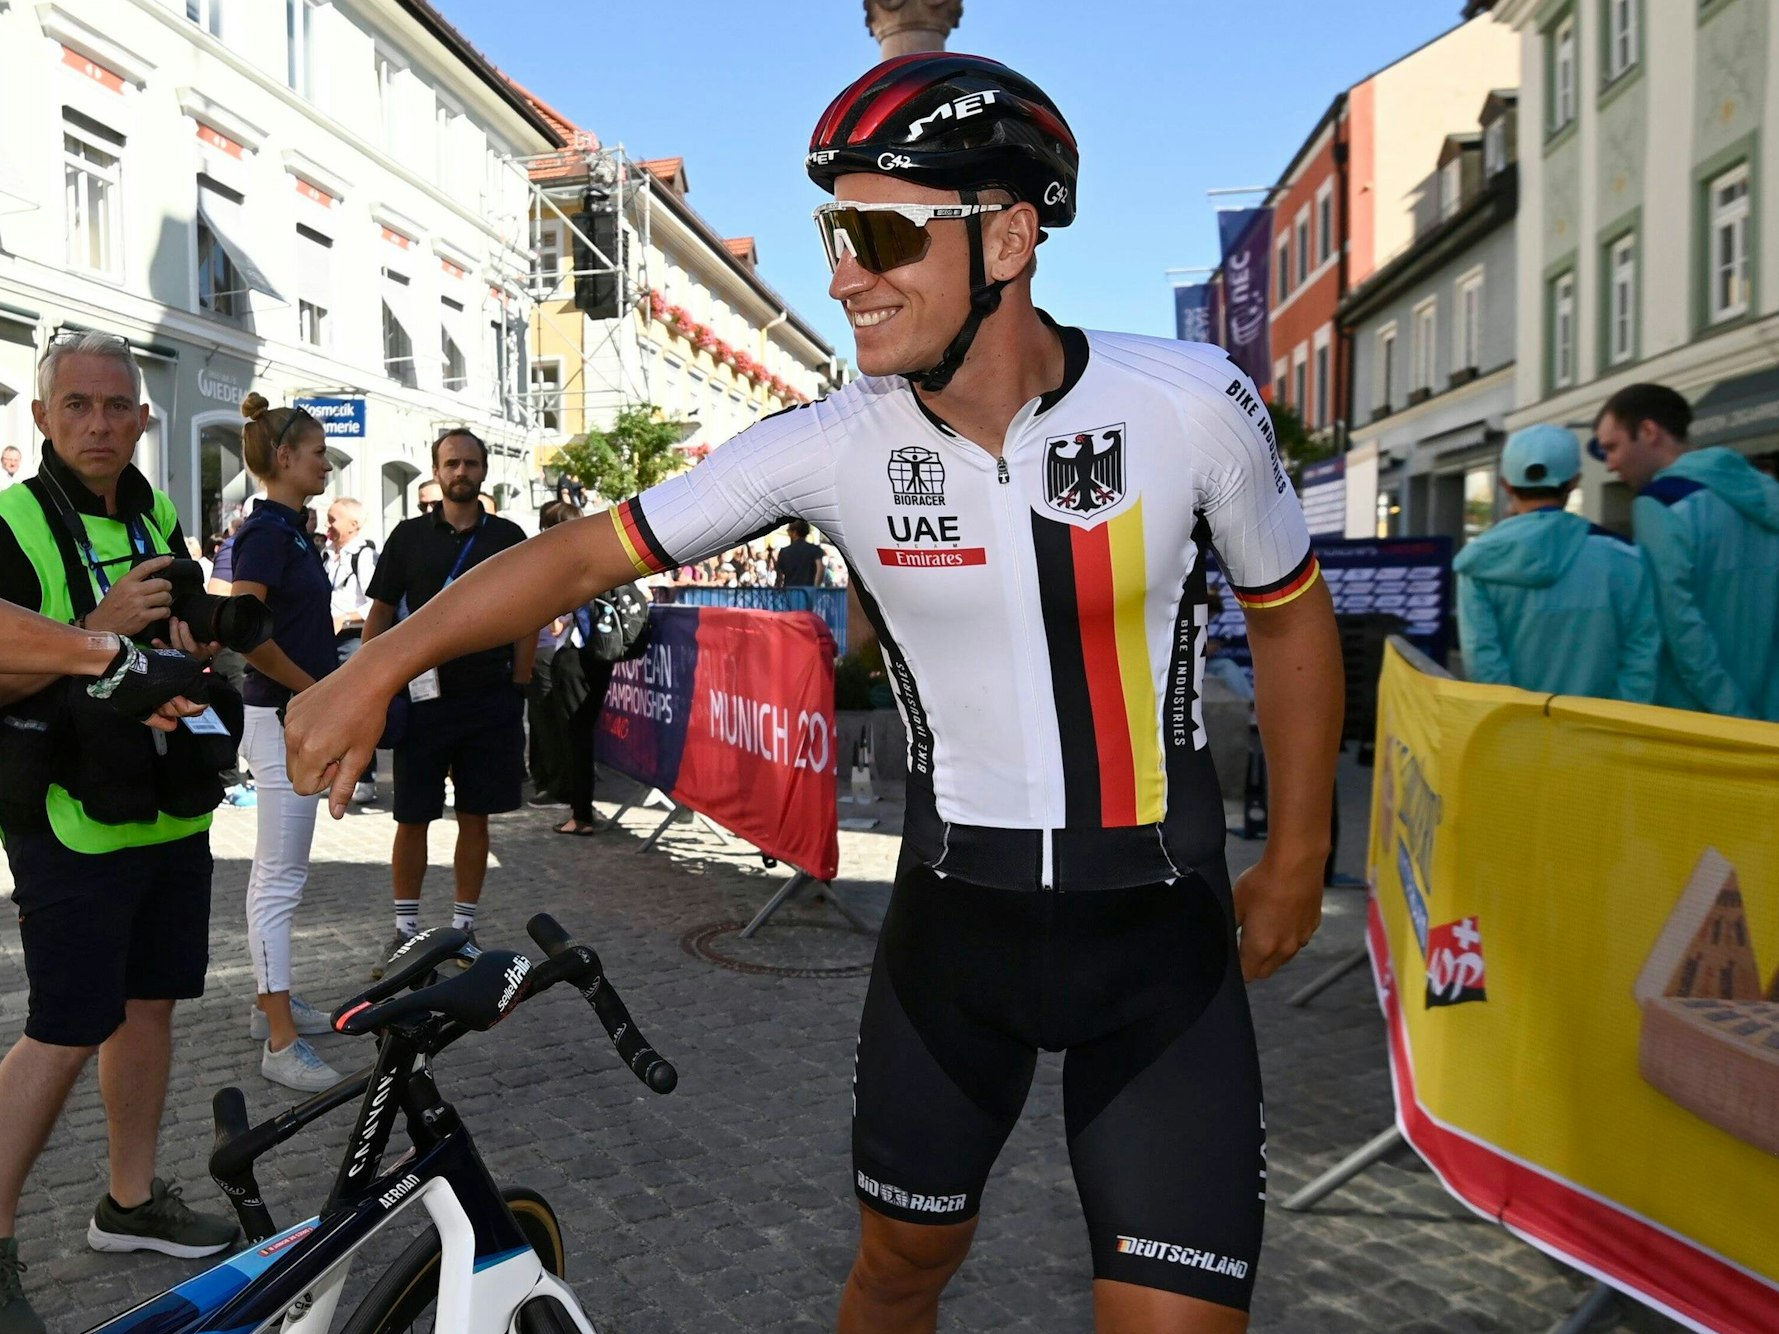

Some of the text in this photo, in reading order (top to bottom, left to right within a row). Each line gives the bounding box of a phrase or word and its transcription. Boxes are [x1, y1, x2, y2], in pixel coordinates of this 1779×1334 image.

[903, 89, 1001, 143] MET
[808, 149, 840, 166] MET
[877, 152, 912, 171] G42
[1225, 379, 1259, 417] BIKE
[324, 420, 360, 434] merie
[894, 495, 946, 506] BIORACER
[887, 515, 961, 542] UAE
[895, 551, 963, 567] Emirates
[1172, 619, 1189, 746] BIKE INDUSTRIES
[604, 681, 673, 724] HAMPIONSHIPS
[709, 688, 837, 776] MUNICH 20
[917, 742, 928, 774] BIKE
[378, 1173, 421, 1210] AEROAD
[909, 1193, 967, 1213] RACER
[1116, 1234, 1249, 1280] DEUTSCHLAND
